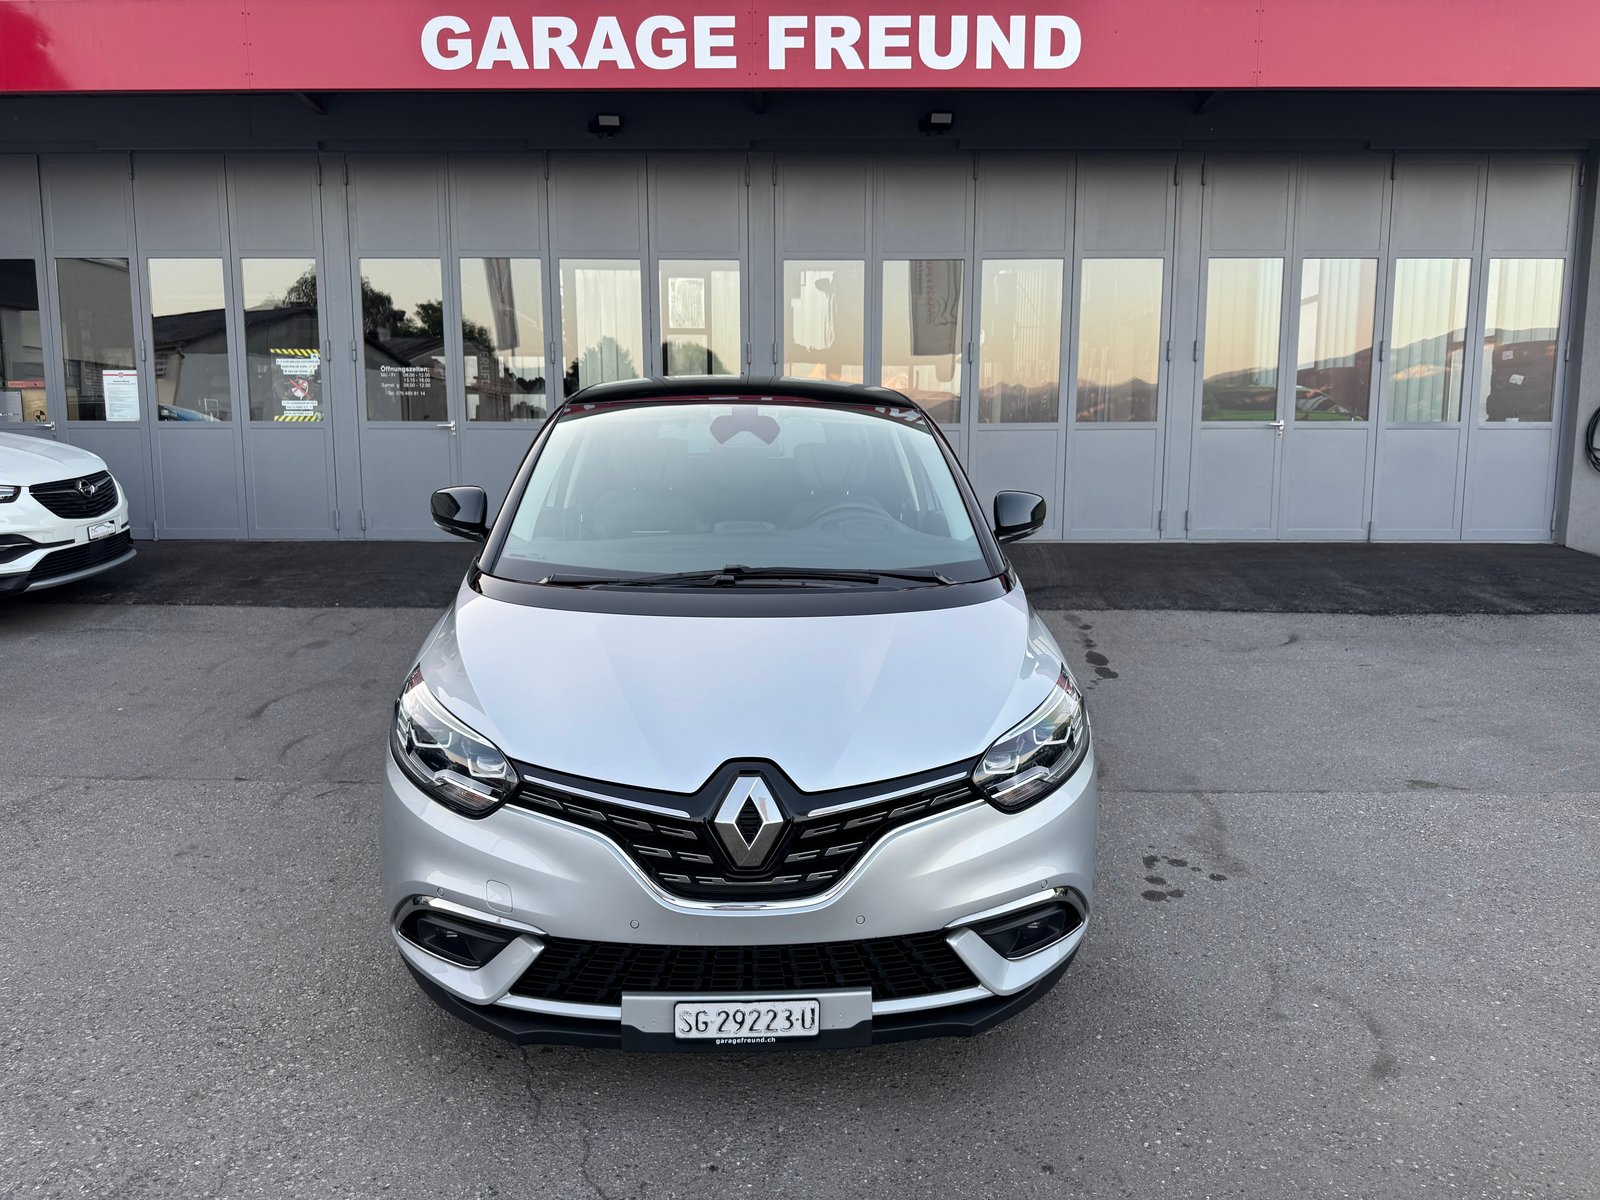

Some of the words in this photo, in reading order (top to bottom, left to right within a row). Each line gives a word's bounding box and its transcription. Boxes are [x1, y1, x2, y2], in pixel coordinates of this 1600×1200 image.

[420, 15, 737, 71] GARAGE
[768, 15, 1081, 71] FREUND
[380, 365, 430, 373] Öffnungszeiten:
[716, 1036, 776, 1045] garagefreund.ch
